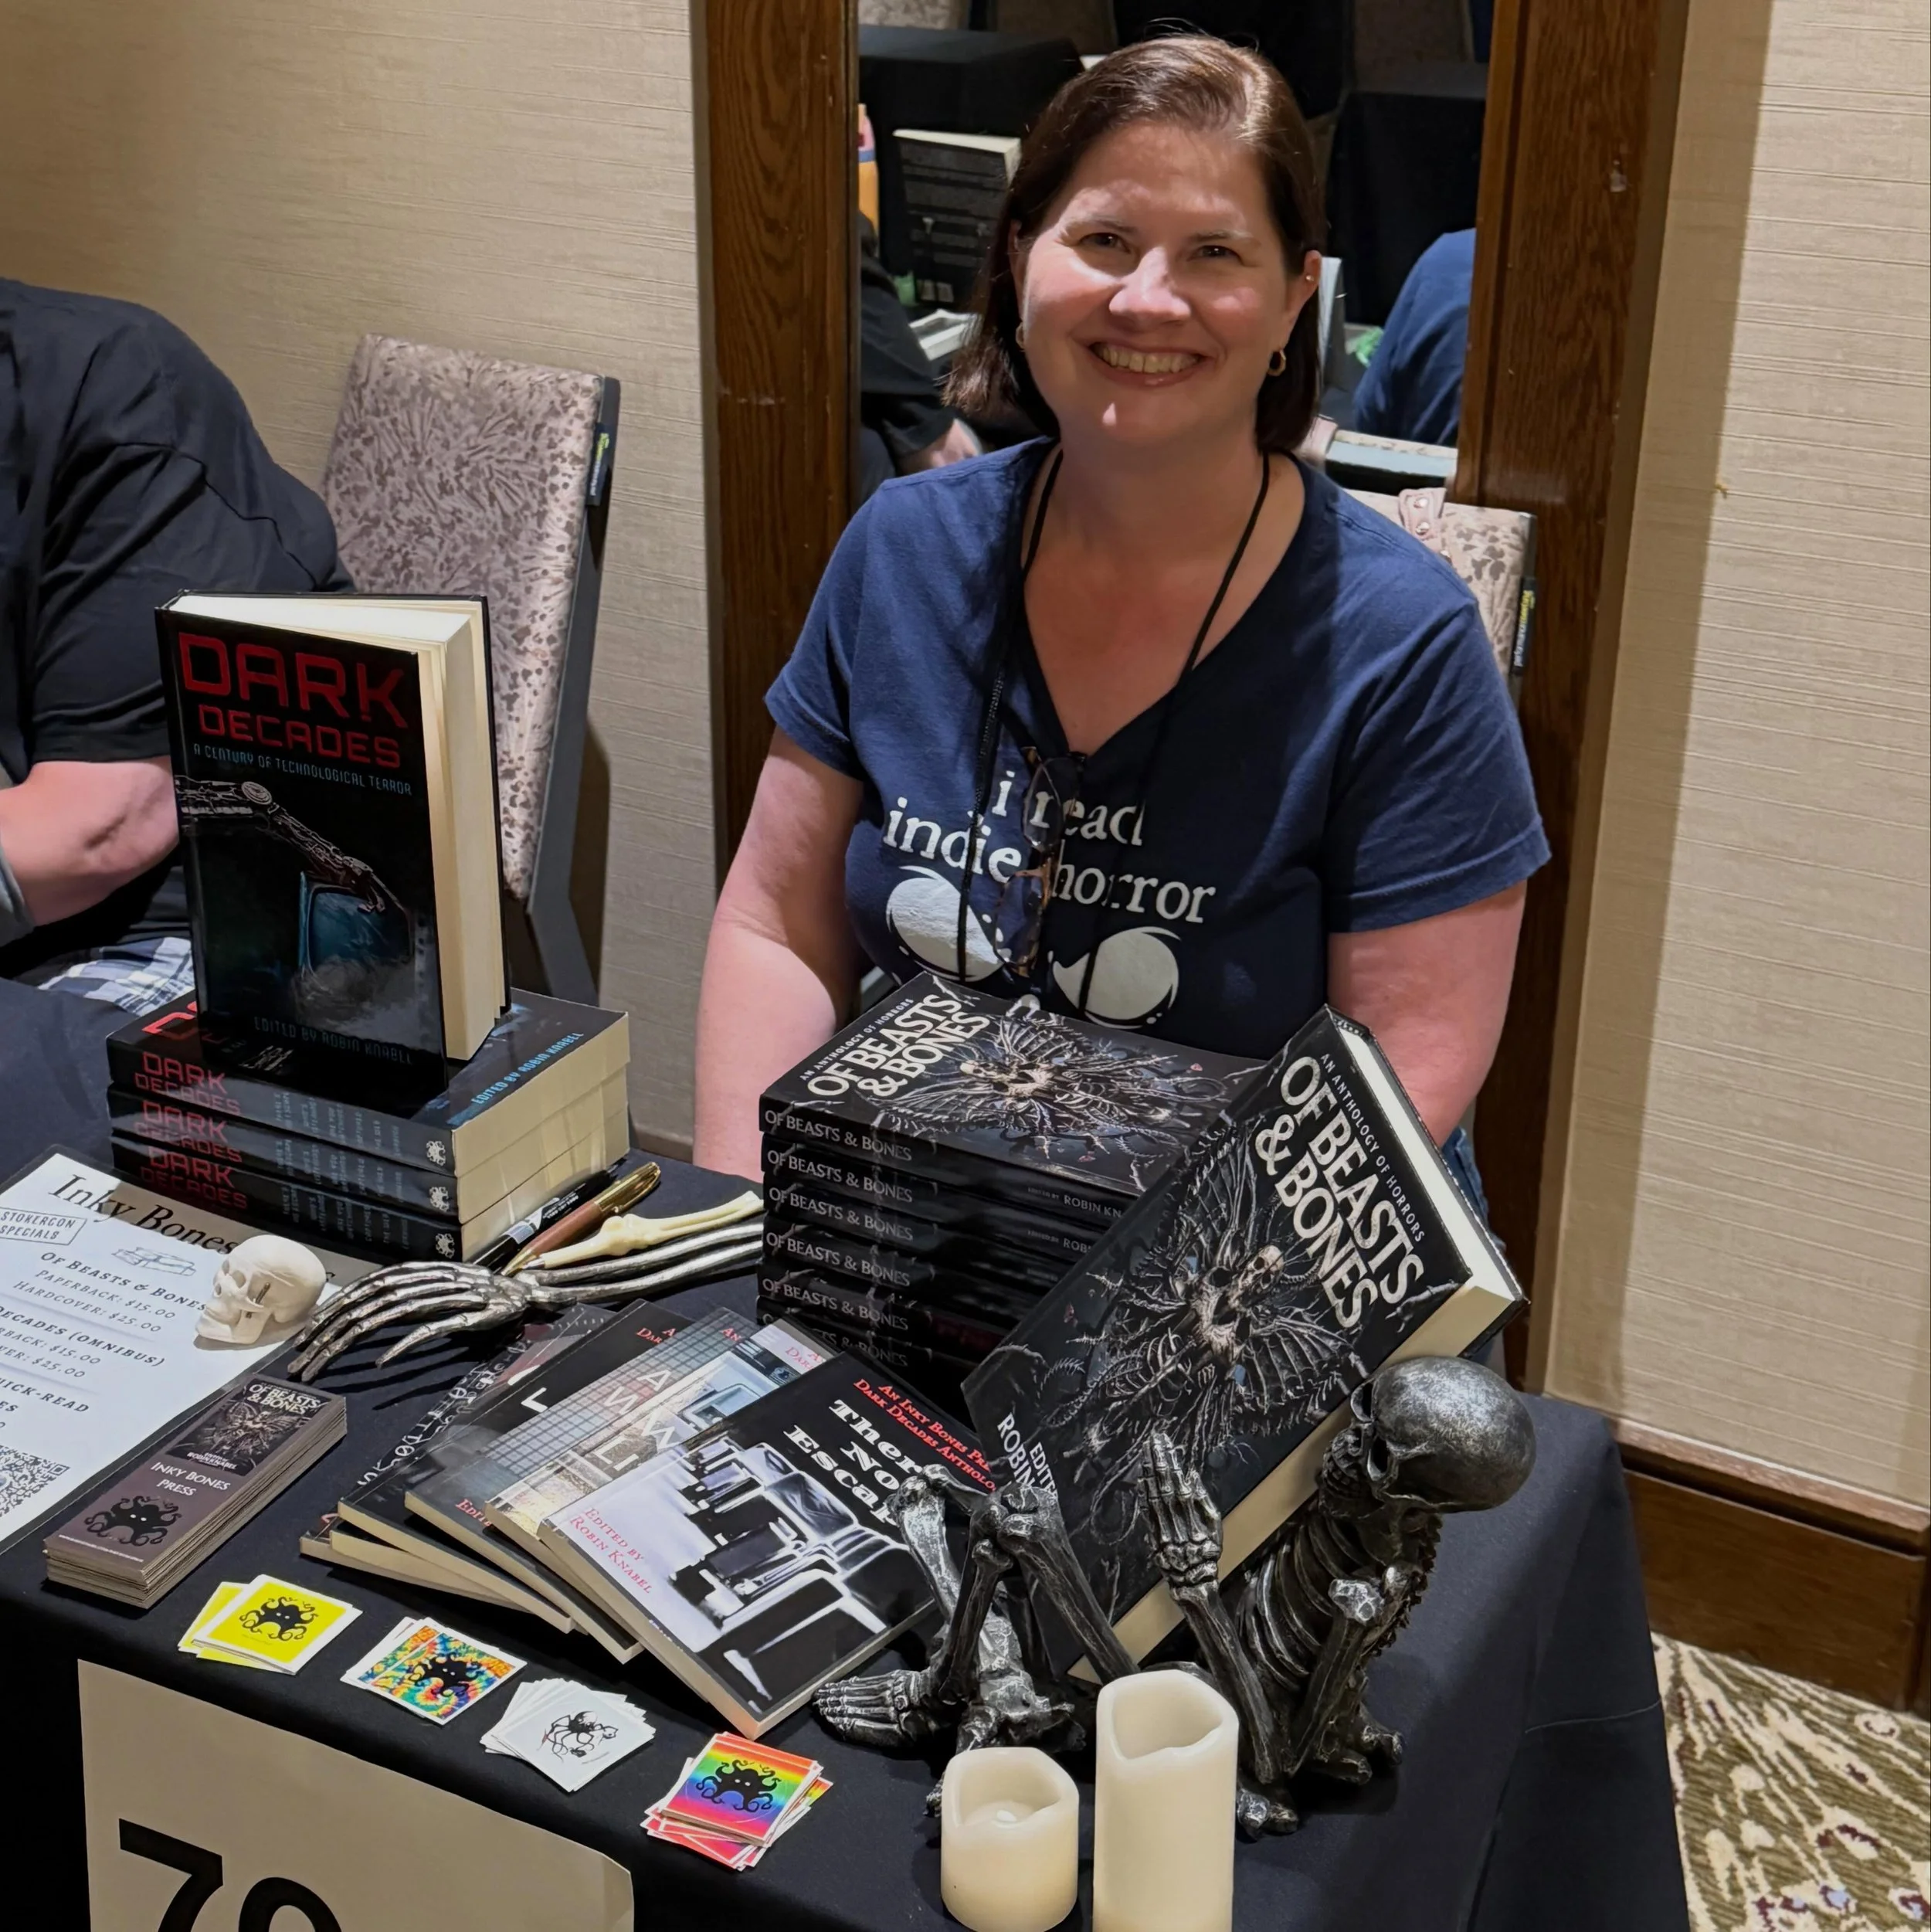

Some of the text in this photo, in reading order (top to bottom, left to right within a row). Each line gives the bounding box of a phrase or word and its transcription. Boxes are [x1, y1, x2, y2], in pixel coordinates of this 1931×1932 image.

[178, 632, 408, 728] DARK
[199, 704, 401, 769] DECADES
[193, 742, 412, 796] A CENTURY OF TECHNOLOGICAL TERROR
[991, 770, 1016, 817] i
[882, 796, 1022, 883] indie
[253, 1017, 297, 1038] EDITED
[301, 1026, 317, 1042] BY
[321, 1030, 361, 1052] ROBIN
[799, 997, 915, 1081] AN ANTHOLOGY OF HORRORS
[807, 994, 962, 1096] OF BEASTS
[857, 1011, 991, 1097] & BONES
[134, 1071, 242, 1116] DECADES
[142, 1051, 228, 1095] DARK
[471, 1032, 585, 1105] EDITED BY ROBIN KNABEL
[134, 1122, 243, 1163] DECADES
[142, 1102, 229, 1144] DARK
[765, 1110, 913, 1161] OF BEASTS & BONES
[1320, 1053, 1425, 1243] AN ANTHOLOGY OF HORRORS
[140, 1166, 248, 1210] DECADES
[148, 1146, 236, 1189] DARK
[767, 1149, 913, 1203] OF BEASTS & BONES
[1280, 1056, 1425, 1304] OF BEASTS
[1, 1210, 76, 1229] STOKERCON
[48, 1173, 136, 1223] Inky
[135, 1203, 239, 1255] Bones
[769, 1187, 913, 1241] OF BEASTS & BONES
[1064, 1194, 1101, 1213] ROBIN
[1254, 1113, 1379, 1329] & BONES
[0, 1224, 60, 1240] SPECIALS
[41, 1251, 207, 1312] OF BEASTS & BONES
[765, 1231, 911, 1288] OF BEASTS & BONES
[13, 1281, 161, 1333] HARDCOVER: $25.00
[36, 1269, 176, 1319] PAPERBACK: $15.00
[762, 1278, 909, 1331] OF BEASTS & BONES
[49, 1343, 100, 1365] $15.00
[69, 1330, 165, 1367] (OMNIBUS)
[636, 1327, 663, 1344] DAR
[32, 1356, 85, 1378] $25.00
[249, 1383, 270, 1395] OF
[266, 1387, 321, 1409] BEASTS
[262, 1395, 310, 1415] BONES
[878, 1385, 899, 1402] AN
[899, 1394, 931, 1424] INKY
[928, 1421, 969, 1454] BONES
[829, 1399, 924, 1475] Ther
[853, 1378, 996, 1493] DARK DECADES ANTHOLO
[997, 1412, 1037, 1489] ROBIN
[151, 1462, 230, 1491] INKY BONES
[157, 1479, 197, 1496] PRESS
[570, 1516, 653, 1594] ROBIN KNABEL
[584, 1507, 644, 1562] EDITED BY
